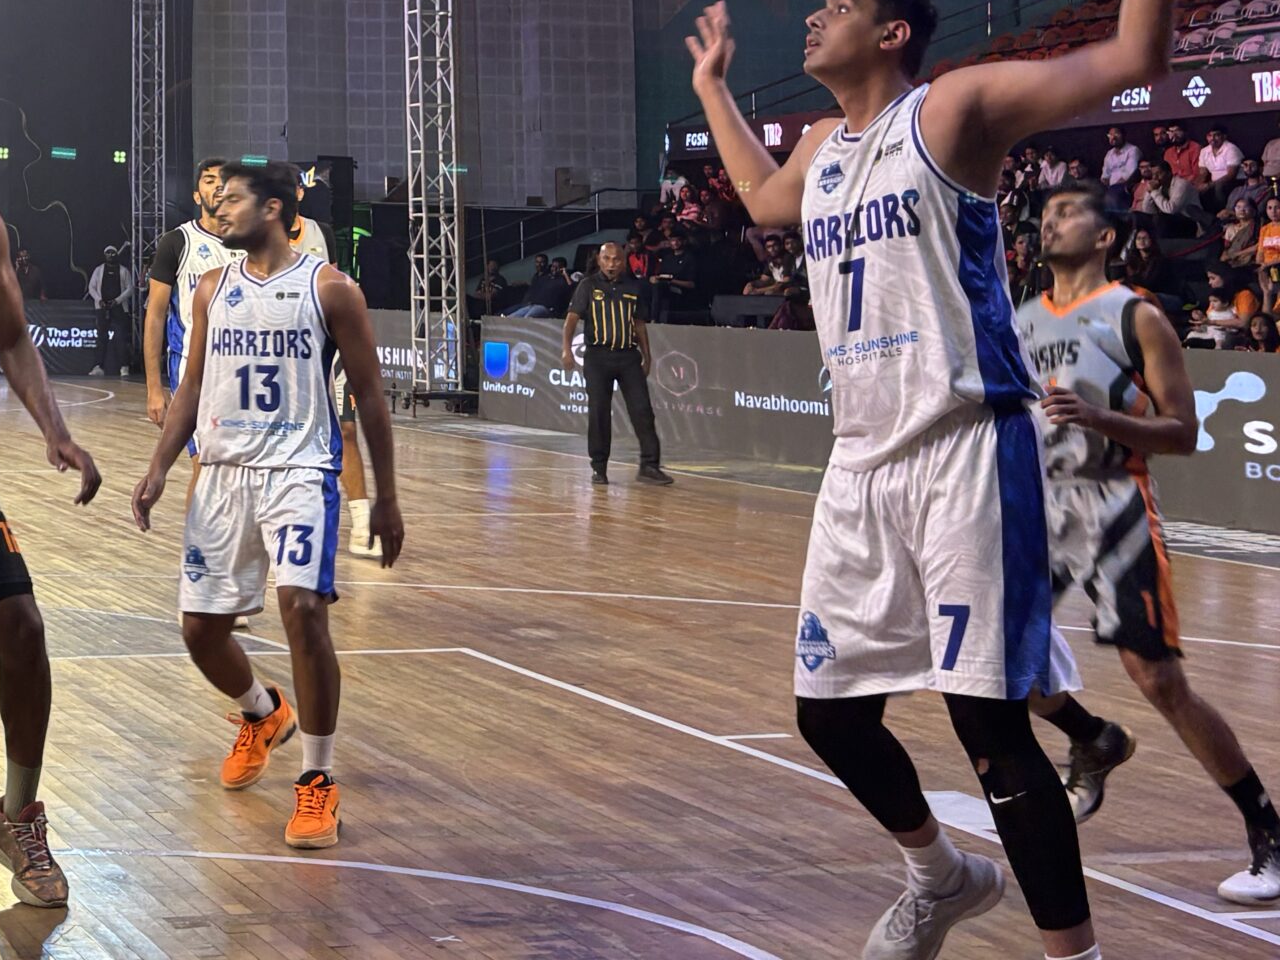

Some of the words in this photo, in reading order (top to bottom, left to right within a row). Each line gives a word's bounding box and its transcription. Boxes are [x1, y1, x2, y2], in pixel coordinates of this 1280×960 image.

[1182, 87, 1211, 97] NIVIA
[838, 256, 865, 332] 7
[47, 327, 69, 338] The
[47, 338, 82, 348] World
[211, 327, 313, 359] WARRIORS
[838, 348, 903, 366] HOSPITALS
[235, 364, 281, 412] 13
[483, 381, 514, 393] United
[516, 384, 535, 398] Pay
[735, 391, 830, 417] Navabhoomi
[276, 524, 314, 567] 13
[938, 604, 970, 671] 7
